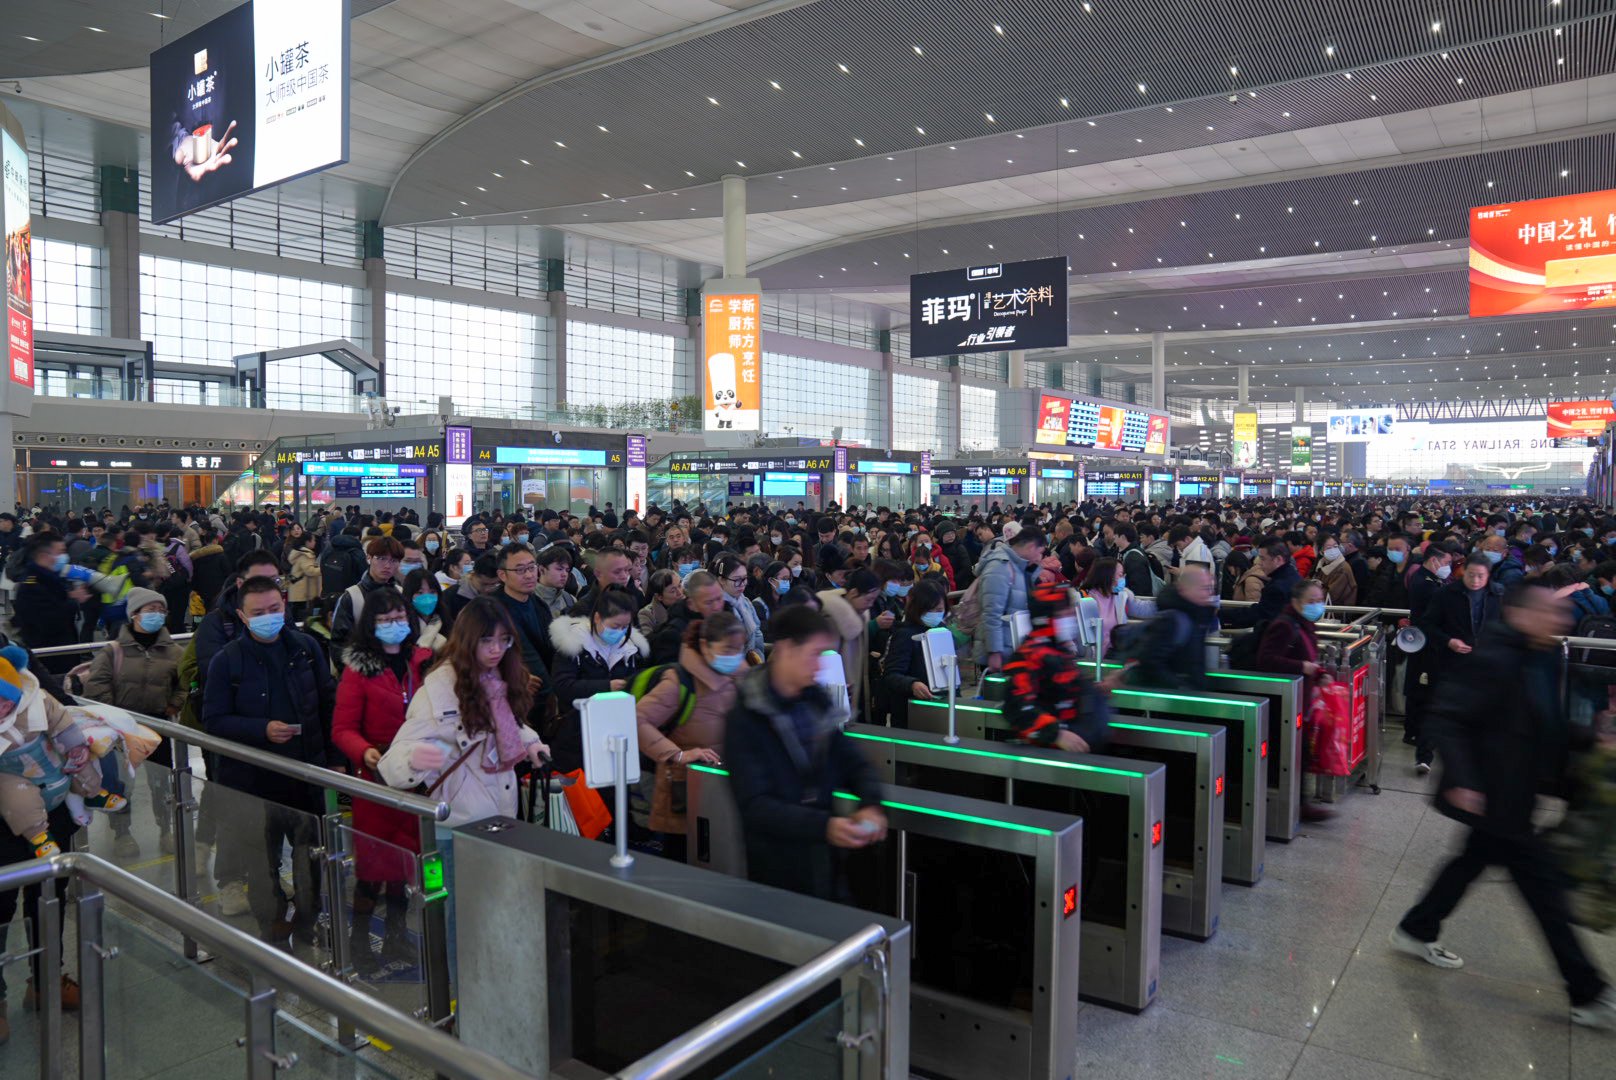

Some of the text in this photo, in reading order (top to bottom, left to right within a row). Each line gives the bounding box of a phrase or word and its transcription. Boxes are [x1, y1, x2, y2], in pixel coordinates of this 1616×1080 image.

[265, 41, 309, 82] 小罐茶
[187, 75, 215, 101] 小罐茶
[266, 63, 329, 107] 大师级中国茶
[1518, 216, 1596, 245] 中国之礼
[921, 295, 971, 325] 菲玛
[992, 285, 1054, 316] 艺术涂料
[728, 299, 742, 348] 学厨师
[741, 298, 755, 383] 新东方烹饪
[180, 455, 222, 469] 银杏厅
[277, 452, 286, 464] A4
[414, 445, 426, 458] A4
[427, 444, 440, 458] A5
[479, 450, 491, 459] A4
[611, 454, 621, 463] A5
[806, 459, 817, 469] A6
[819, 459, 830, 469] A7
[671, 462, 681, 472] A6
[682, 462, 691, 472] A7
